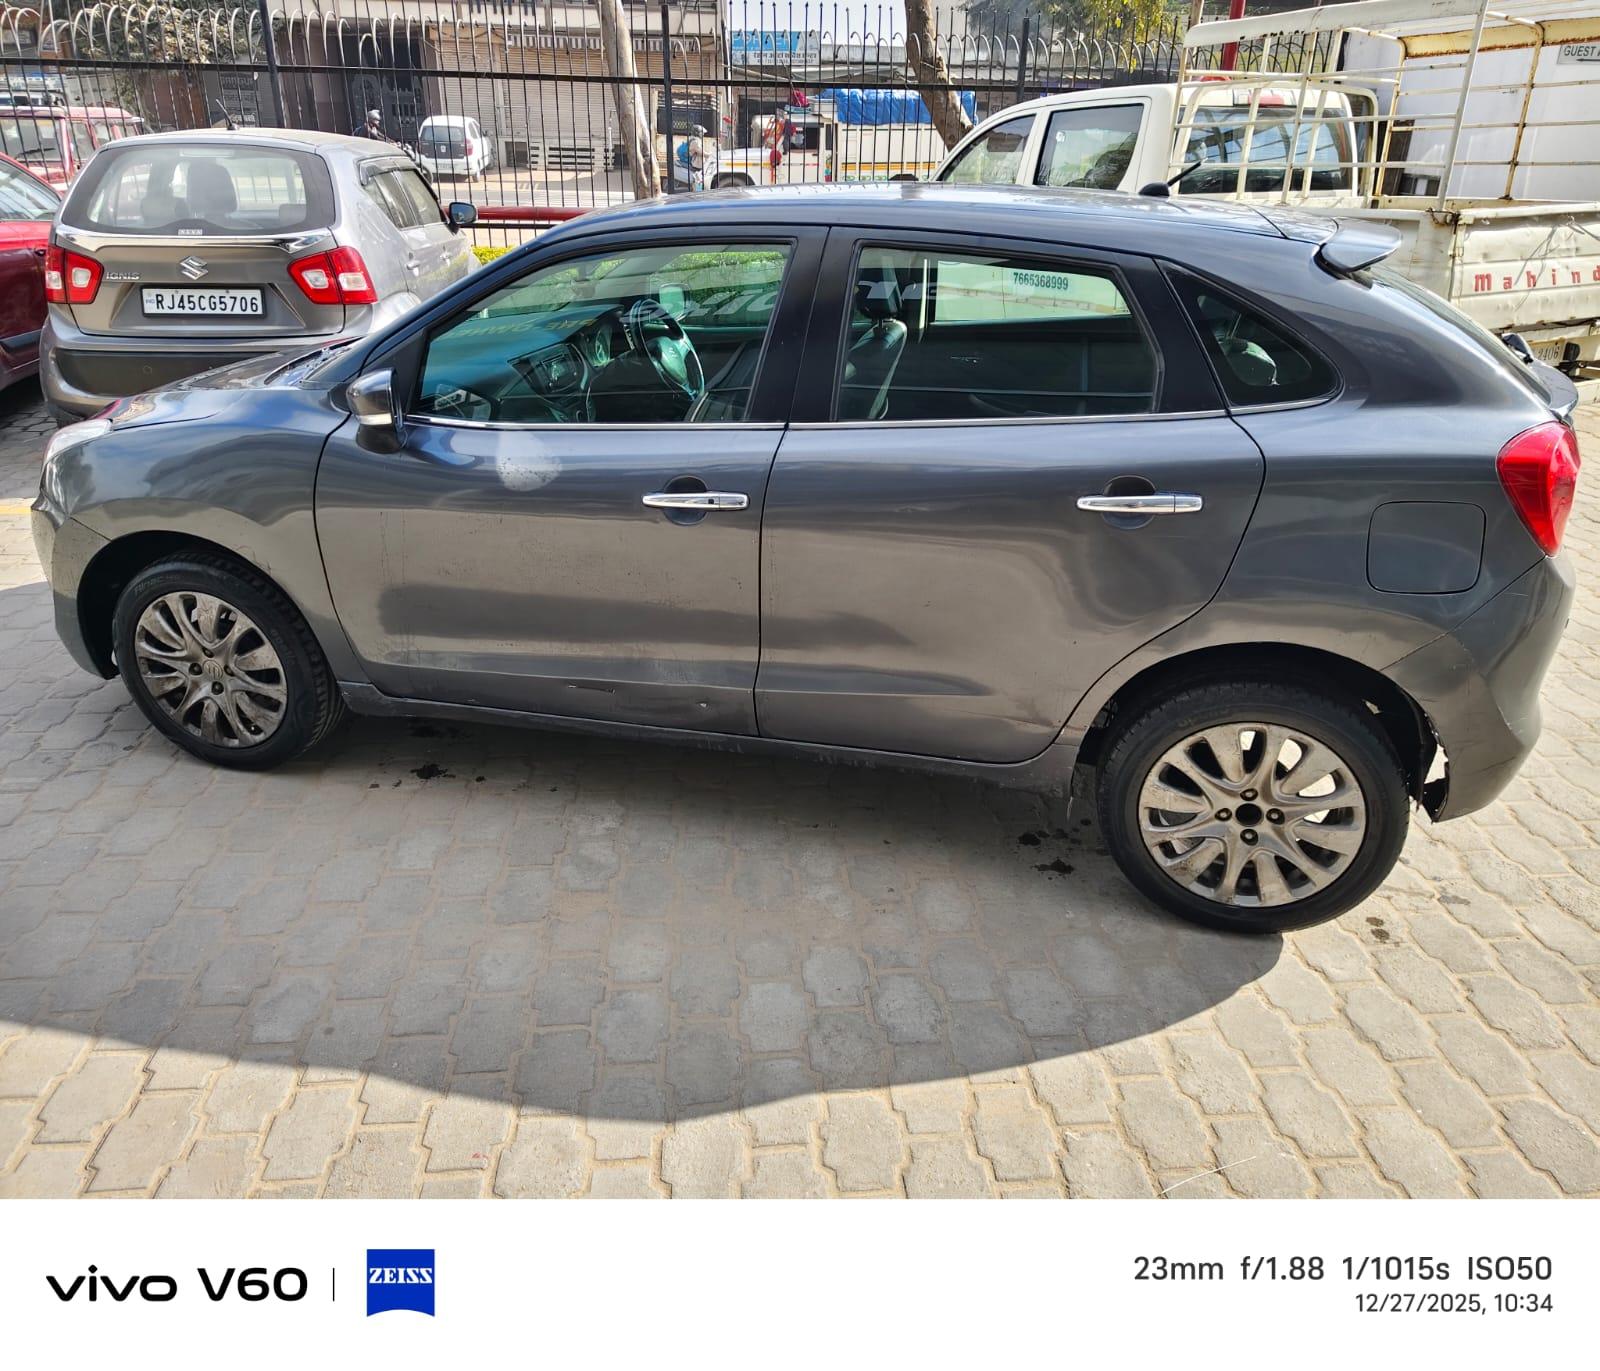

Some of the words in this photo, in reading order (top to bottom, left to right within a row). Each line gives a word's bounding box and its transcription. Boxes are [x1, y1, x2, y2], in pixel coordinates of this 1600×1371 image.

[1564, 45, 1597, 57] GUEST
[106, 271, 140, 280] IGNIS
[155, 293, 259, 313] RJ45CG5706
